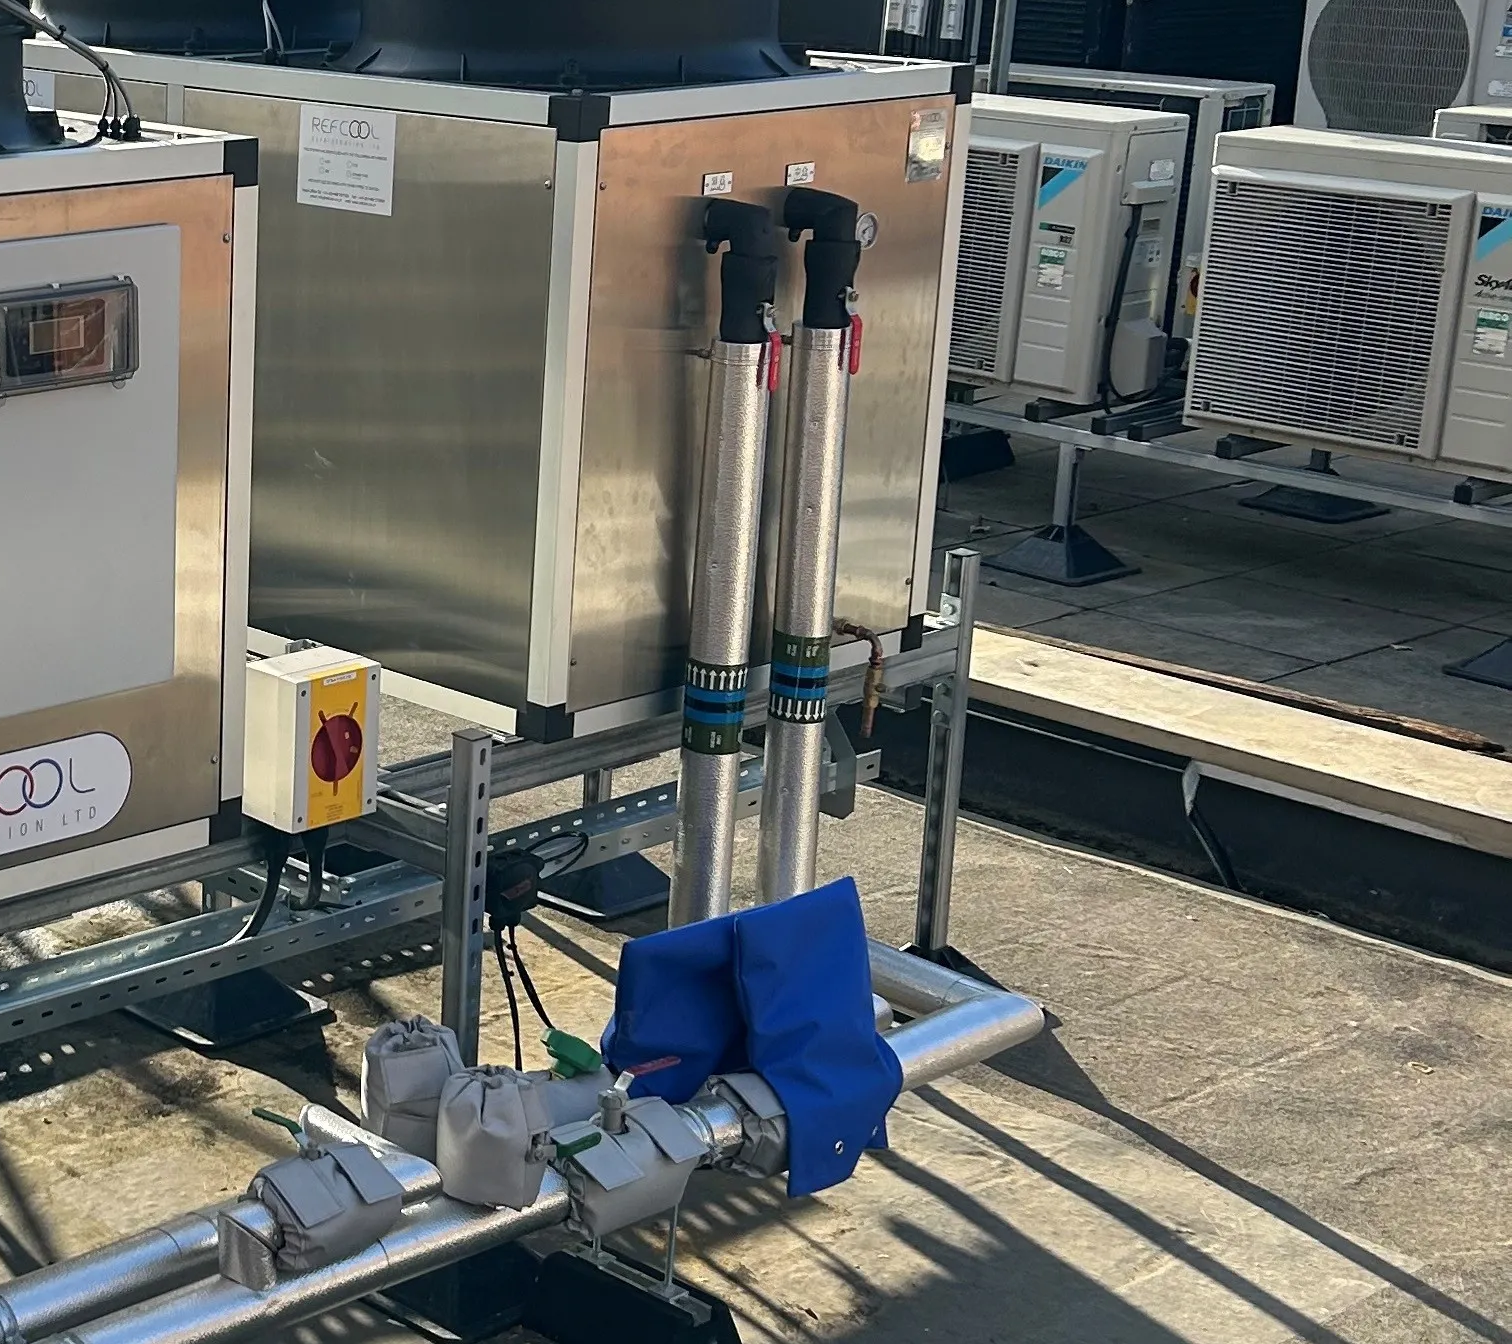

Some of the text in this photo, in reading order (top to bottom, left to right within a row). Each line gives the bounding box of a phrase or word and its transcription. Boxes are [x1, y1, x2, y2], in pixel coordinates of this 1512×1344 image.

[311, 117, 380, 140] REFCOOL
[1043, 156, 1088, 170] DAIKIN
[1482, 206, 1512, 217] DAI
[61, 806, 97, 827] LTD
